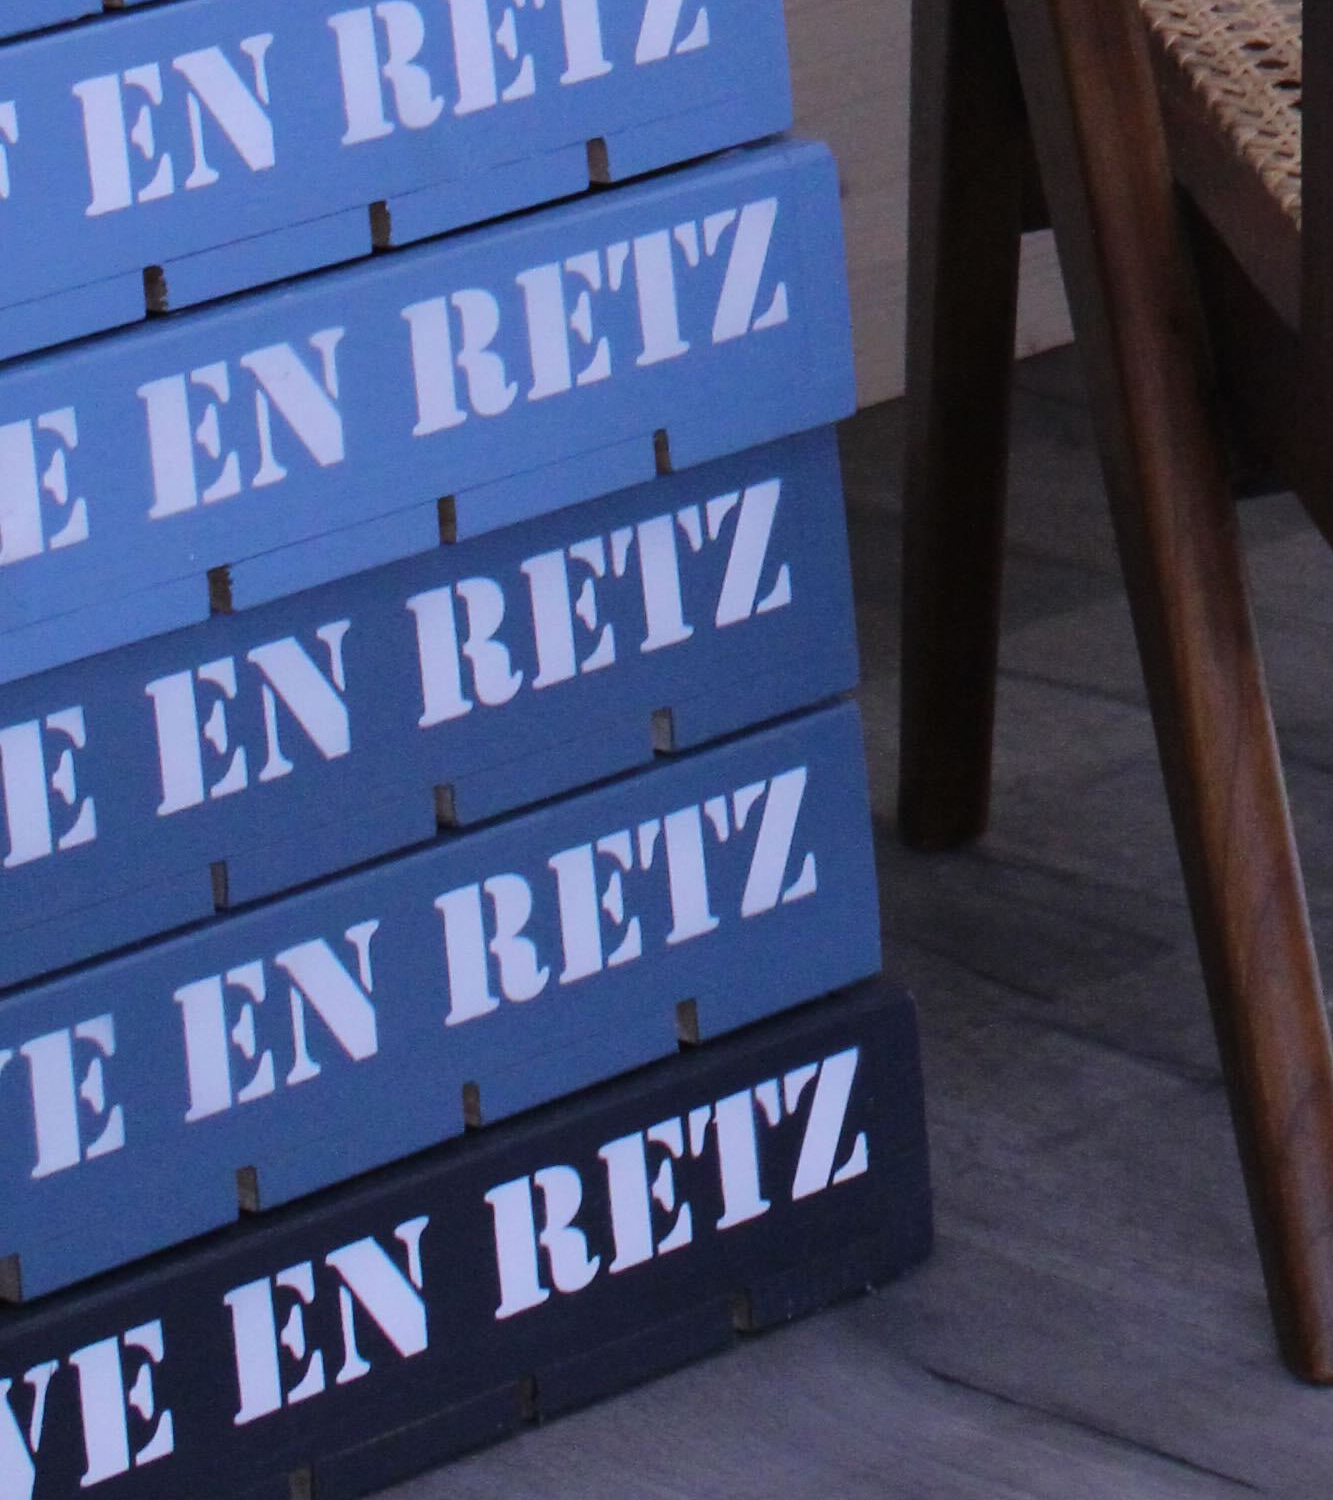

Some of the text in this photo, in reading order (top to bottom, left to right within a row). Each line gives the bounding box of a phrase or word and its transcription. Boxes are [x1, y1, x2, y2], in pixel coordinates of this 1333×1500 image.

[72, 32, 276, 217] EN
[139, 196, 790, 521] EN RETZ
[145, 477, 792, 818] EN RETZ
[174, 765, 818, 1125] EN RETZ
[224, 1215, 431, 1426] EN
[484, 1045, 870, 1321] RETZ
